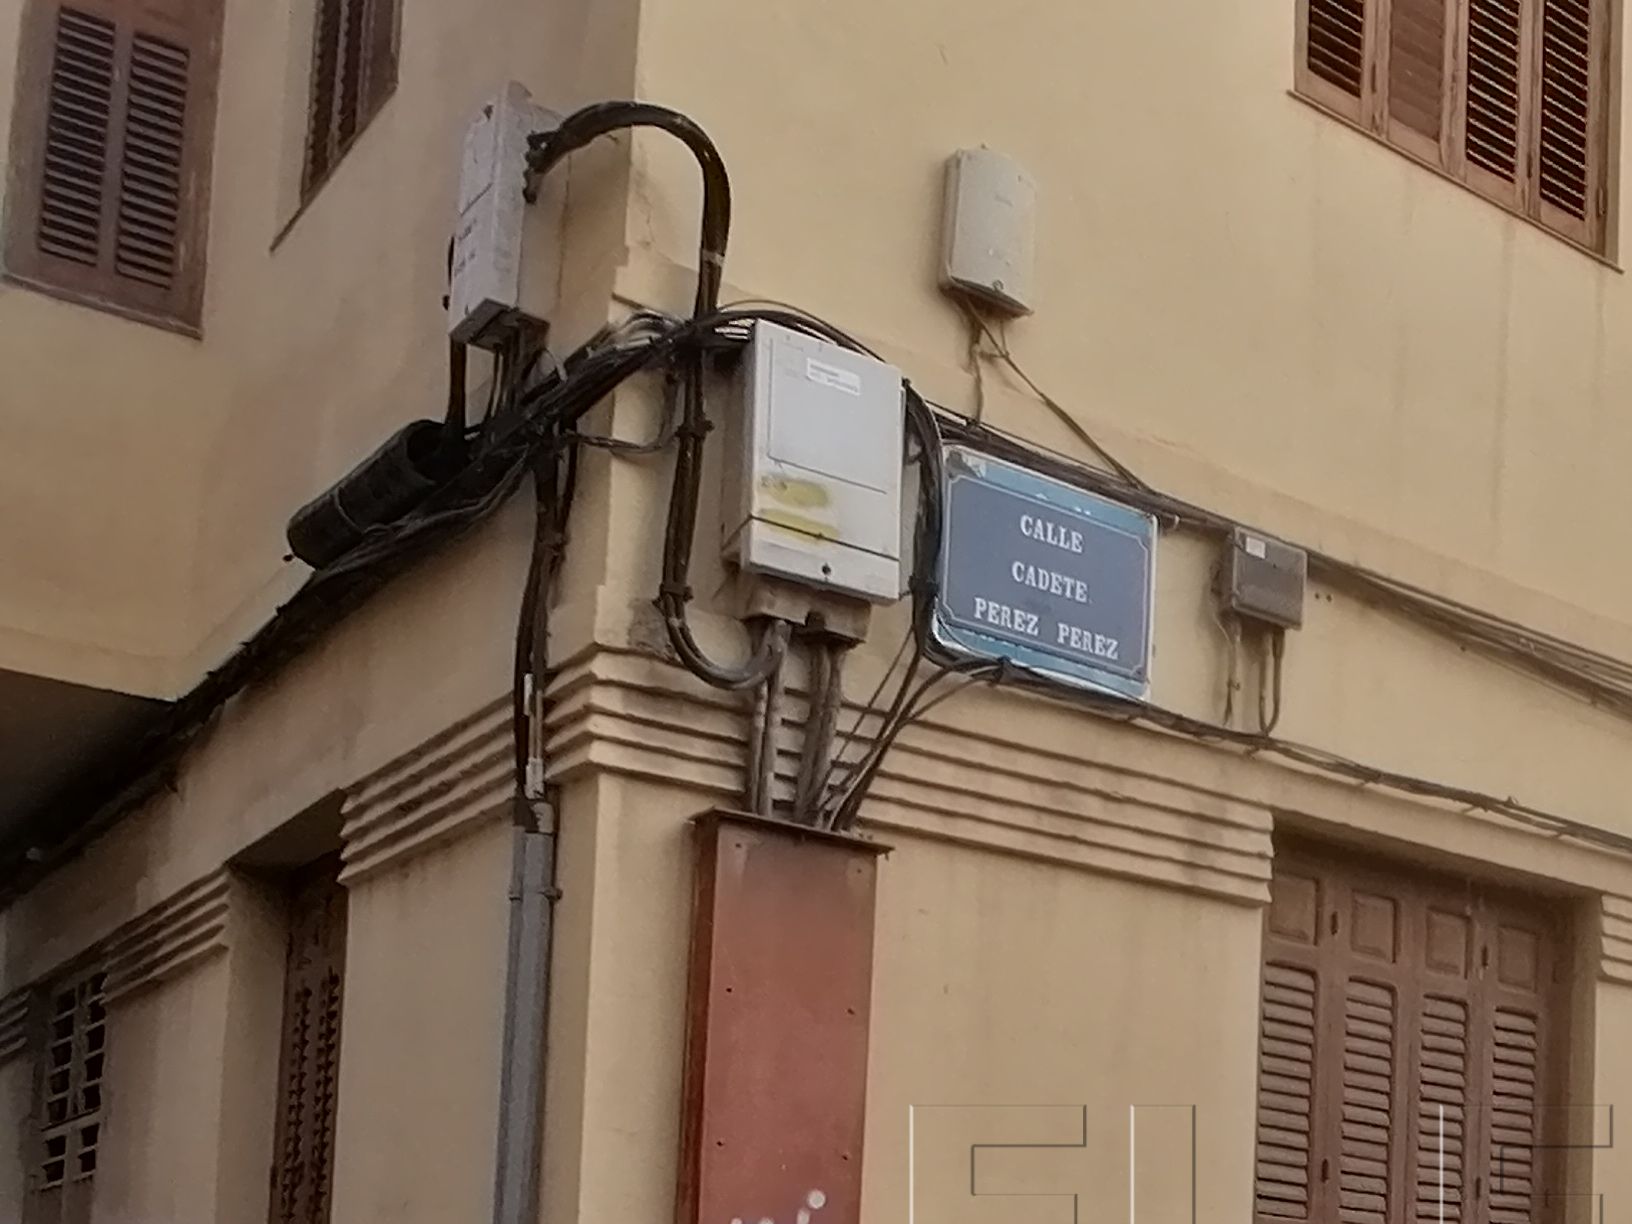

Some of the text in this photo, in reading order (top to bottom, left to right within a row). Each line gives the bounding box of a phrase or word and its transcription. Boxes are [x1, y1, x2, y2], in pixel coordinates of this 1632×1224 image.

[1020, 514, 1083, 554] CALLE
[1011, 560, 1088, 603] CADETE
[973, 597, 1119, 661] PEREZ PEREZ
